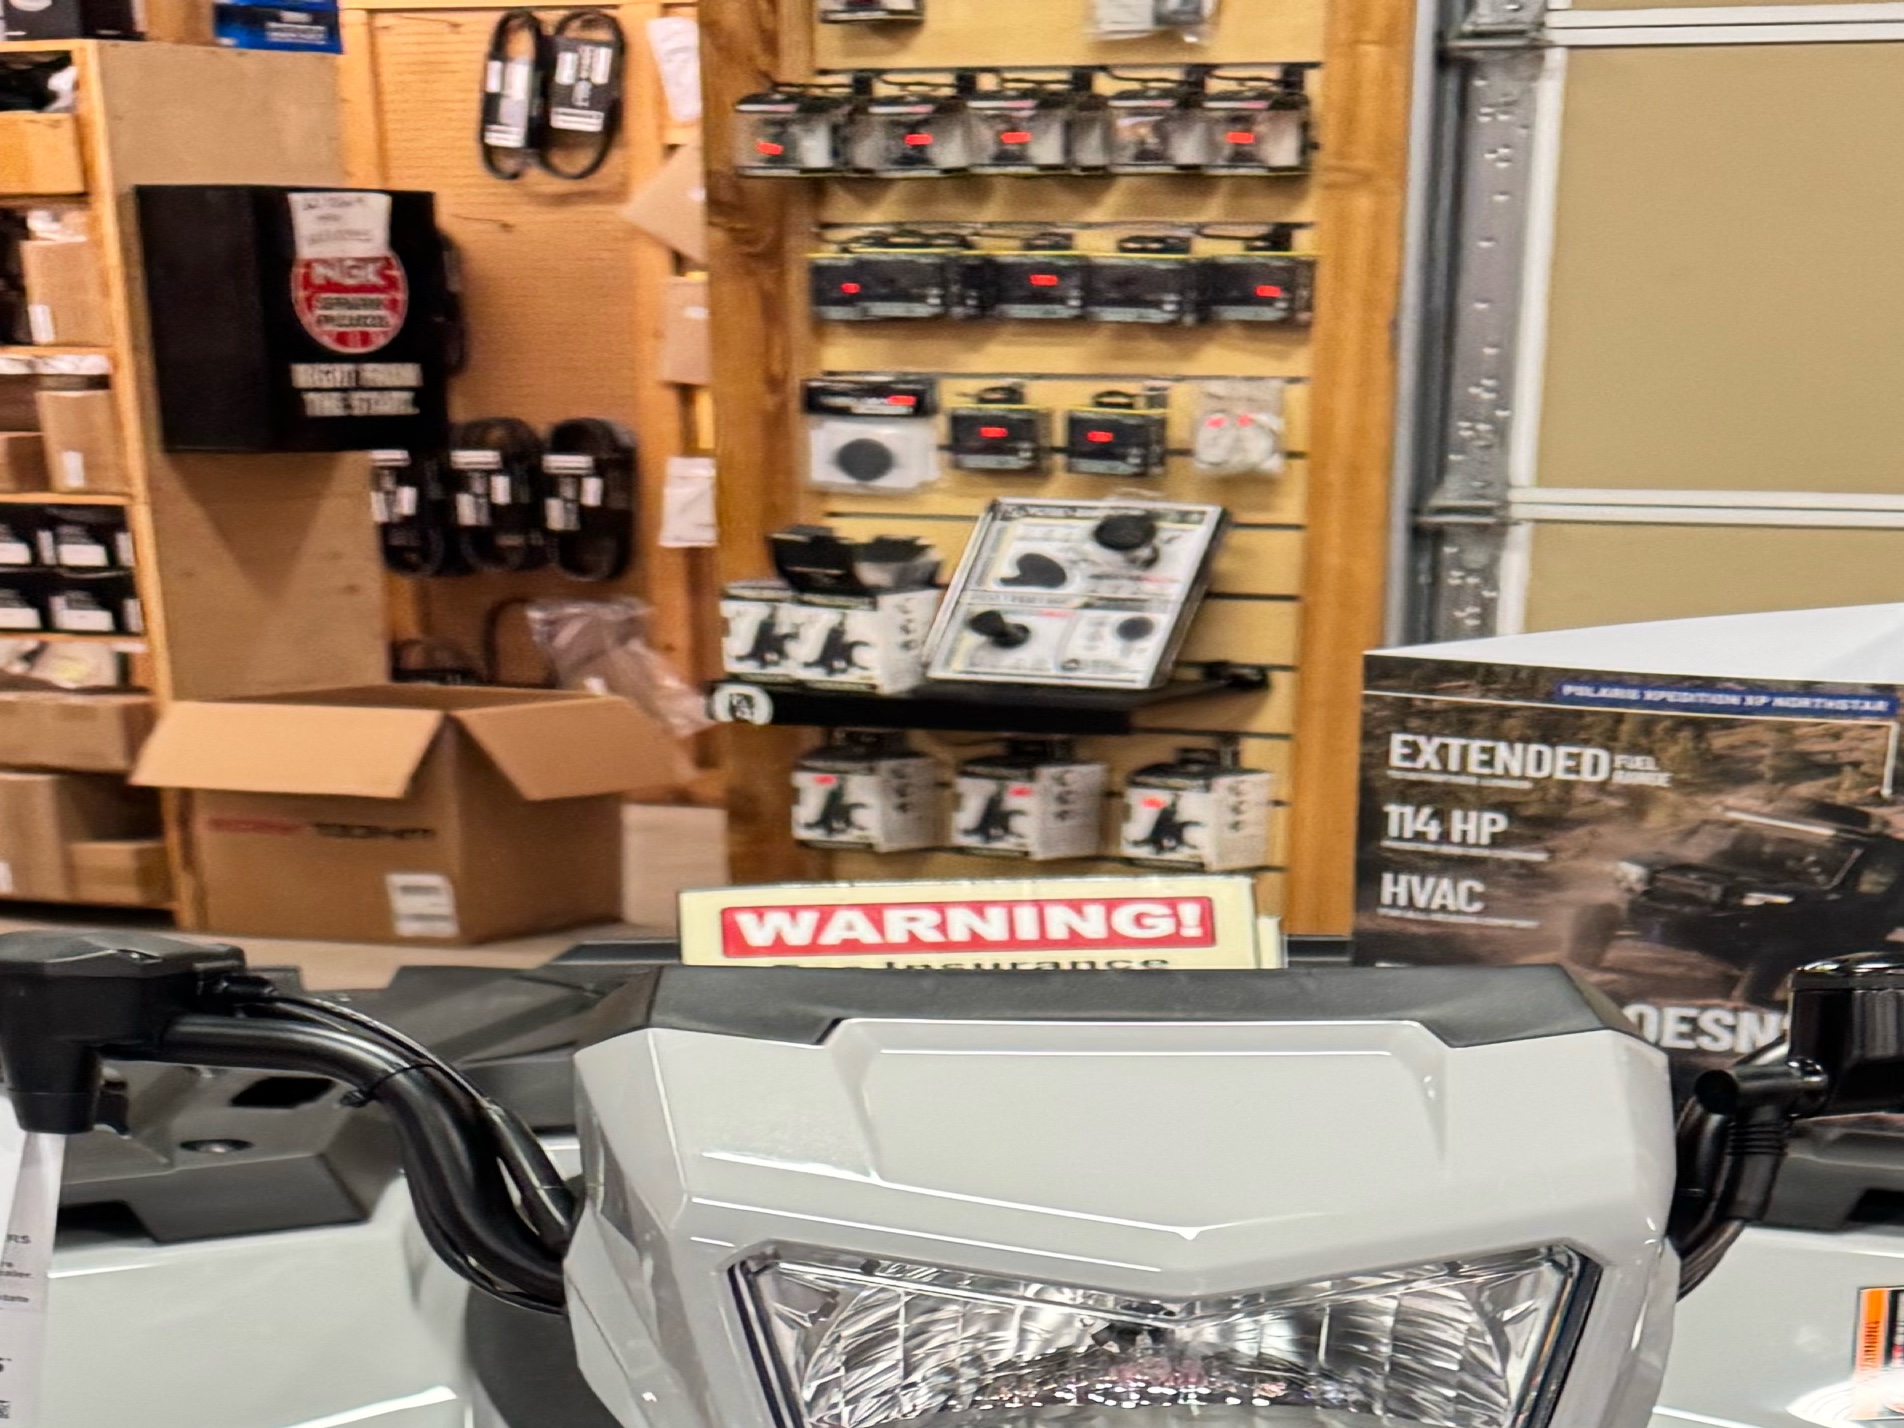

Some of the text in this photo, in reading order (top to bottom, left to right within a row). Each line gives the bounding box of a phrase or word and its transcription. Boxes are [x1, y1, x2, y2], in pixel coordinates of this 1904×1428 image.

[1388, 733, 1612, 783] EXTENDED
[1613, 754, 1659, 771] FUEL
[1383, 803, 1509, 846] 114 HP
[1380, 872, 1486, 914] HVAC
[733, 900, 1205, 948] WARNING!
